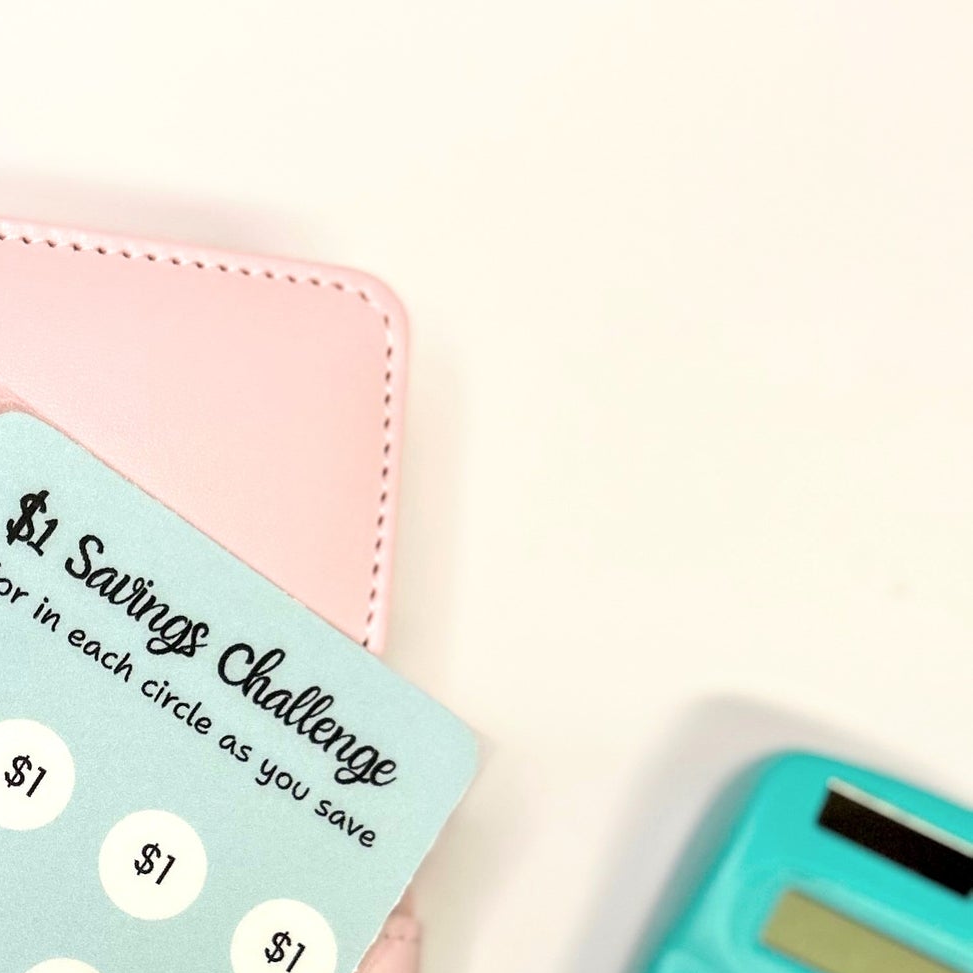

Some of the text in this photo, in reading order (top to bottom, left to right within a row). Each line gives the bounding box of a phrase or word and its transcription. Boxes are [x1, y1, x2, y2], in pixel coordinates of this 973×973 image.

[6, 490, 397, 787] $1 Savings Challenge
[32, 597, 61, 633] in
[67, 629, 134, 683] each
[140, 679, 213, 735] circle
[218, 734, 253, 763] as
[254, 758, 310, 801] you
[314, 799, 376, 848] save
[4, 754, 47, 798] $1
[133, 842, 176, 885] $1
[264, 931, 306, 973] $1
